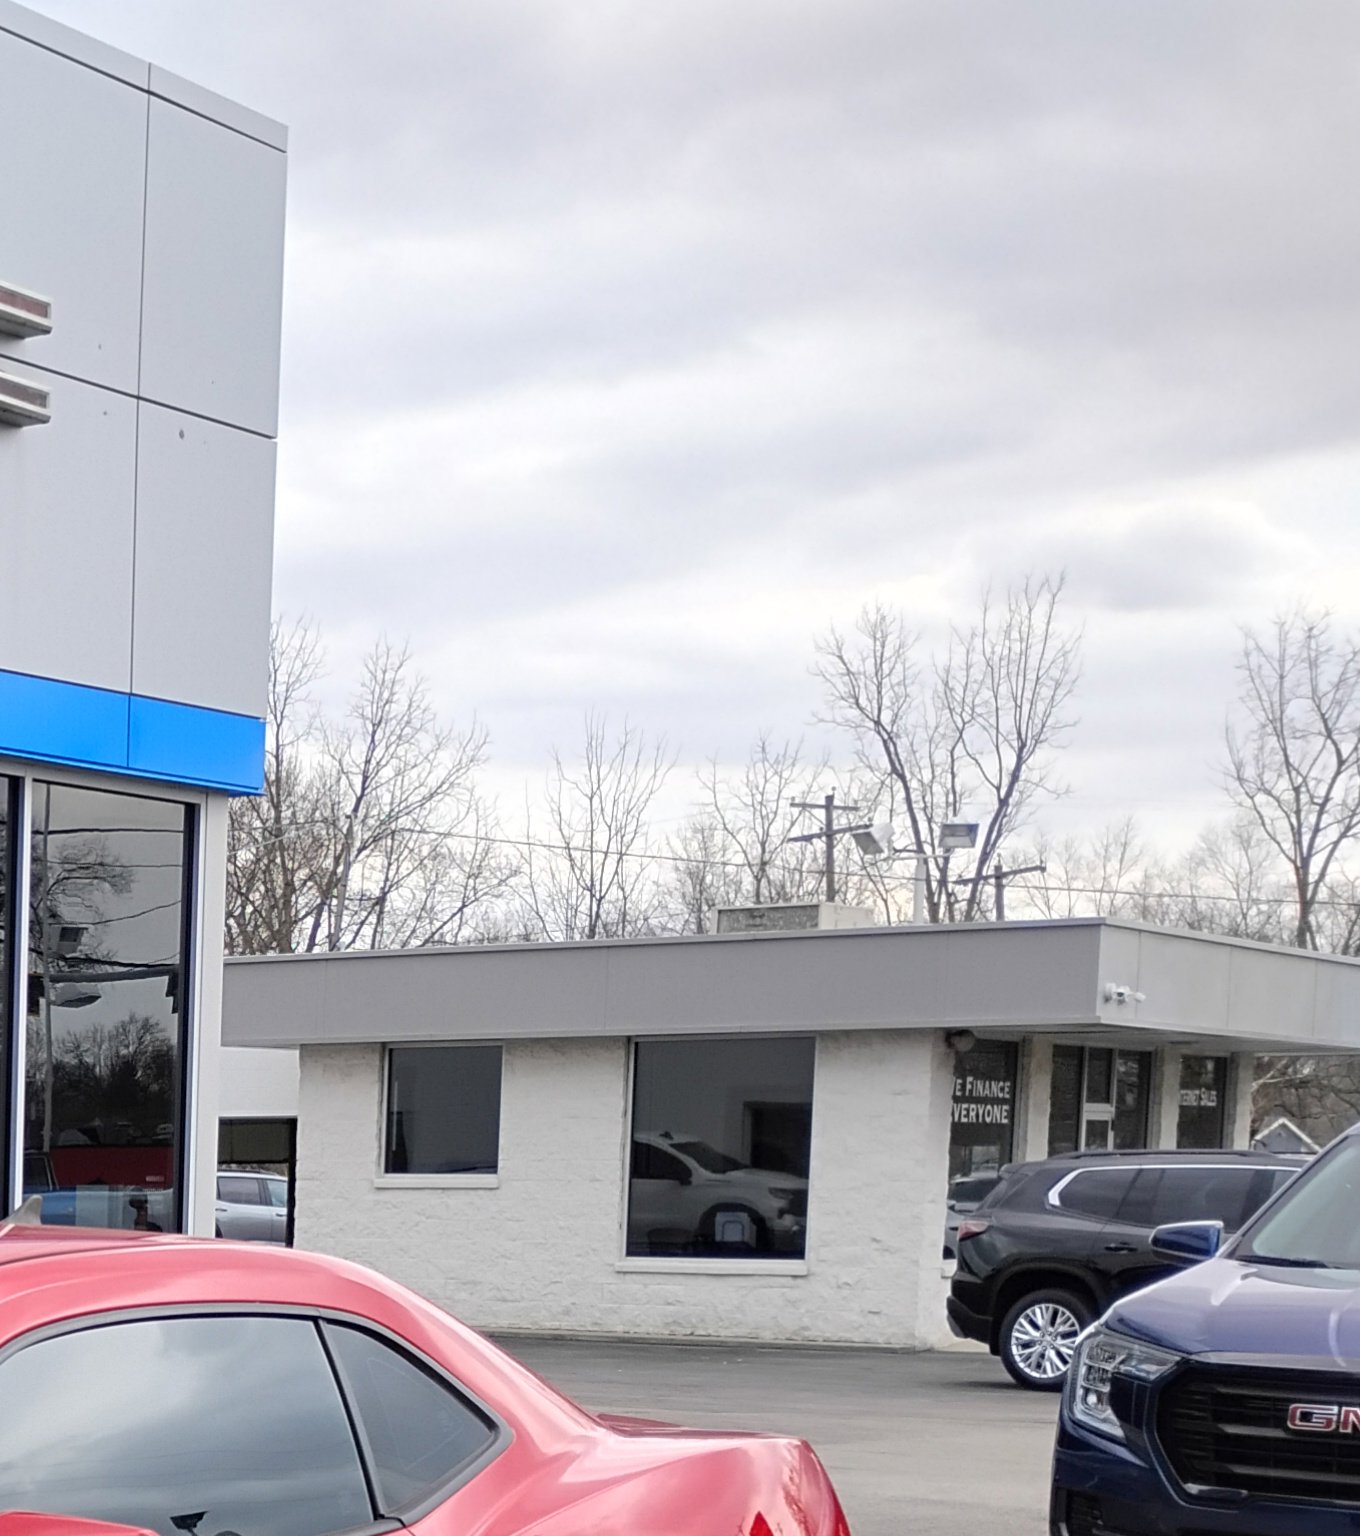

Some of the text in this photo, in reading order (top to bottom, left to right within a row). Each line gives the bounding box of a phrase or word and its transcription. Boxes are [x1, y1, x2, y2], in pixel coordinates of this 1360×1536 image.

[951, 1074, 1011, 1099] E FINANCE
[950, 1103, 1010, 1124] VERYONE
